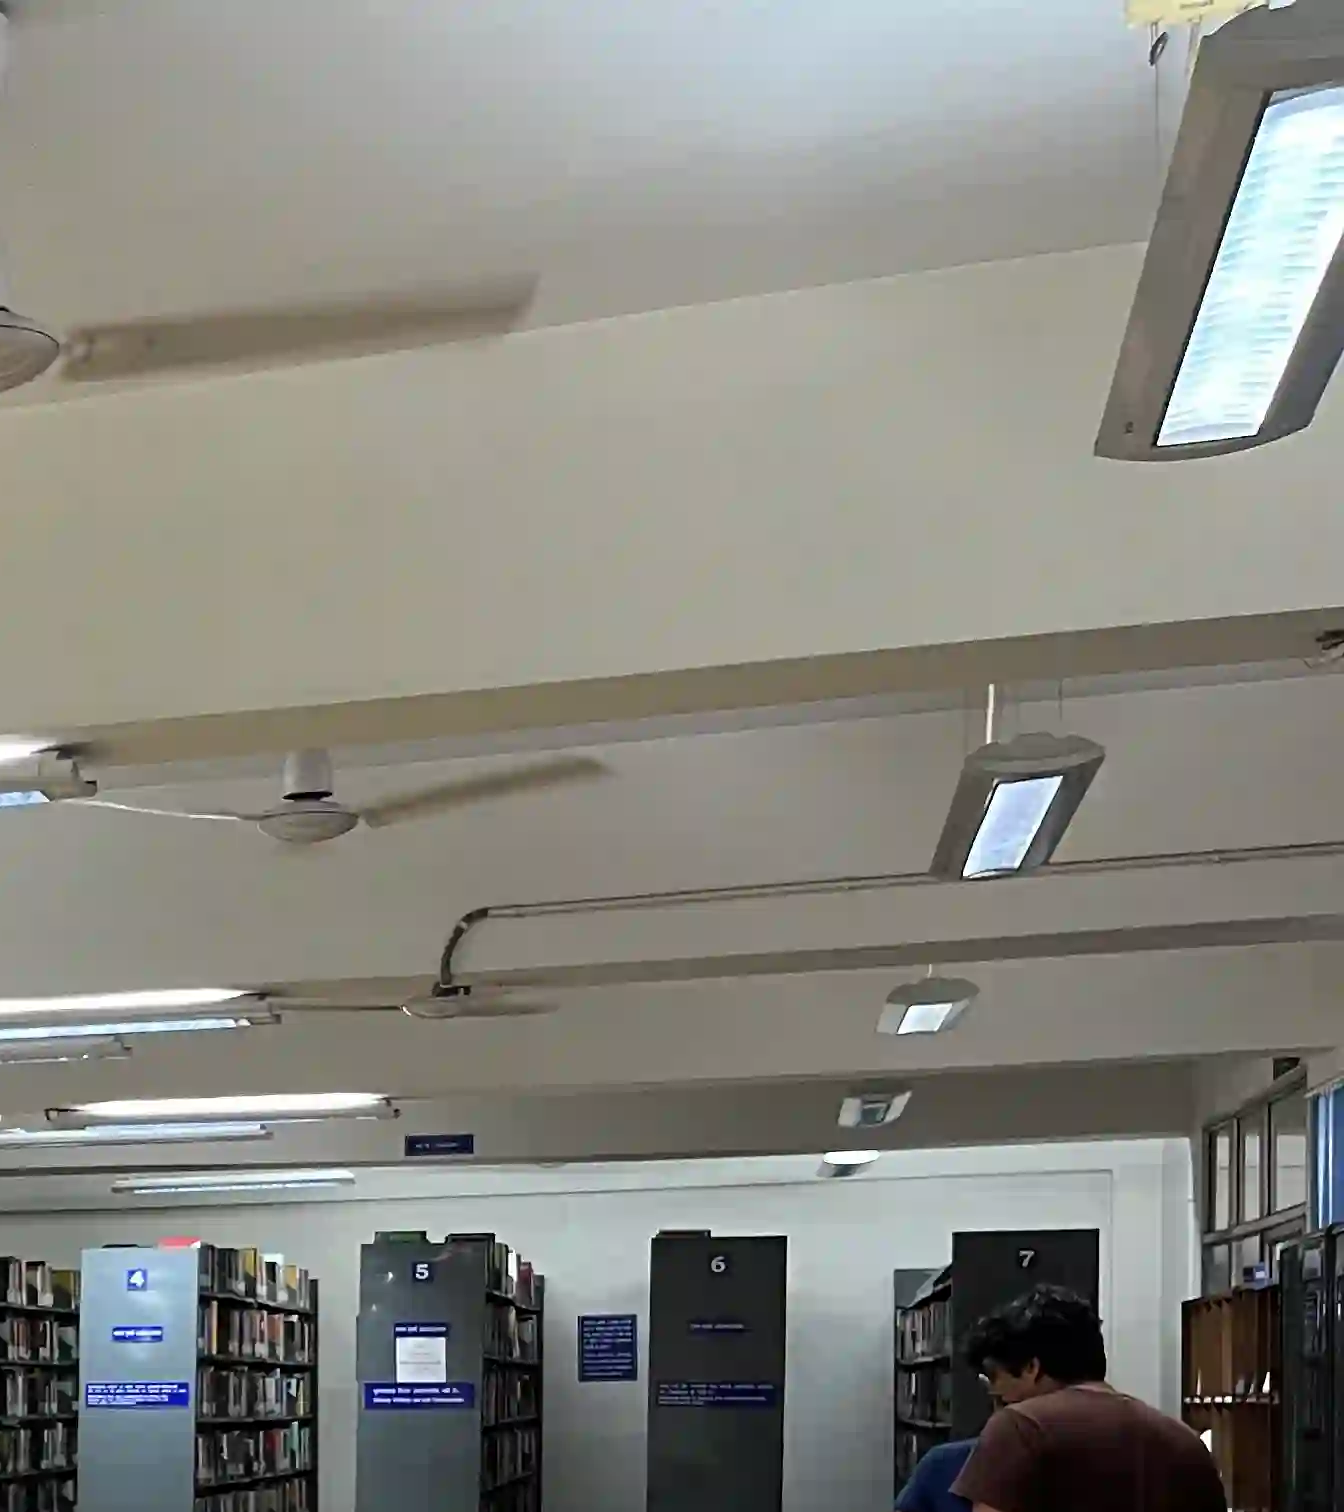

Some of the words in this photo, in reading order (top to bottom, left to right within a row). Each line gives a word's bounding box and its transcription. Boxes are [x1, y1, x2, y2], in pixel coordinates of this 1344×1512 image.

[711, 1256, 726, 1273] 6
[1019, 1250, 1035, 1268] 7
[130, 1269, 145, 1288] 4
[415, 1264, 429, 1280] 5
